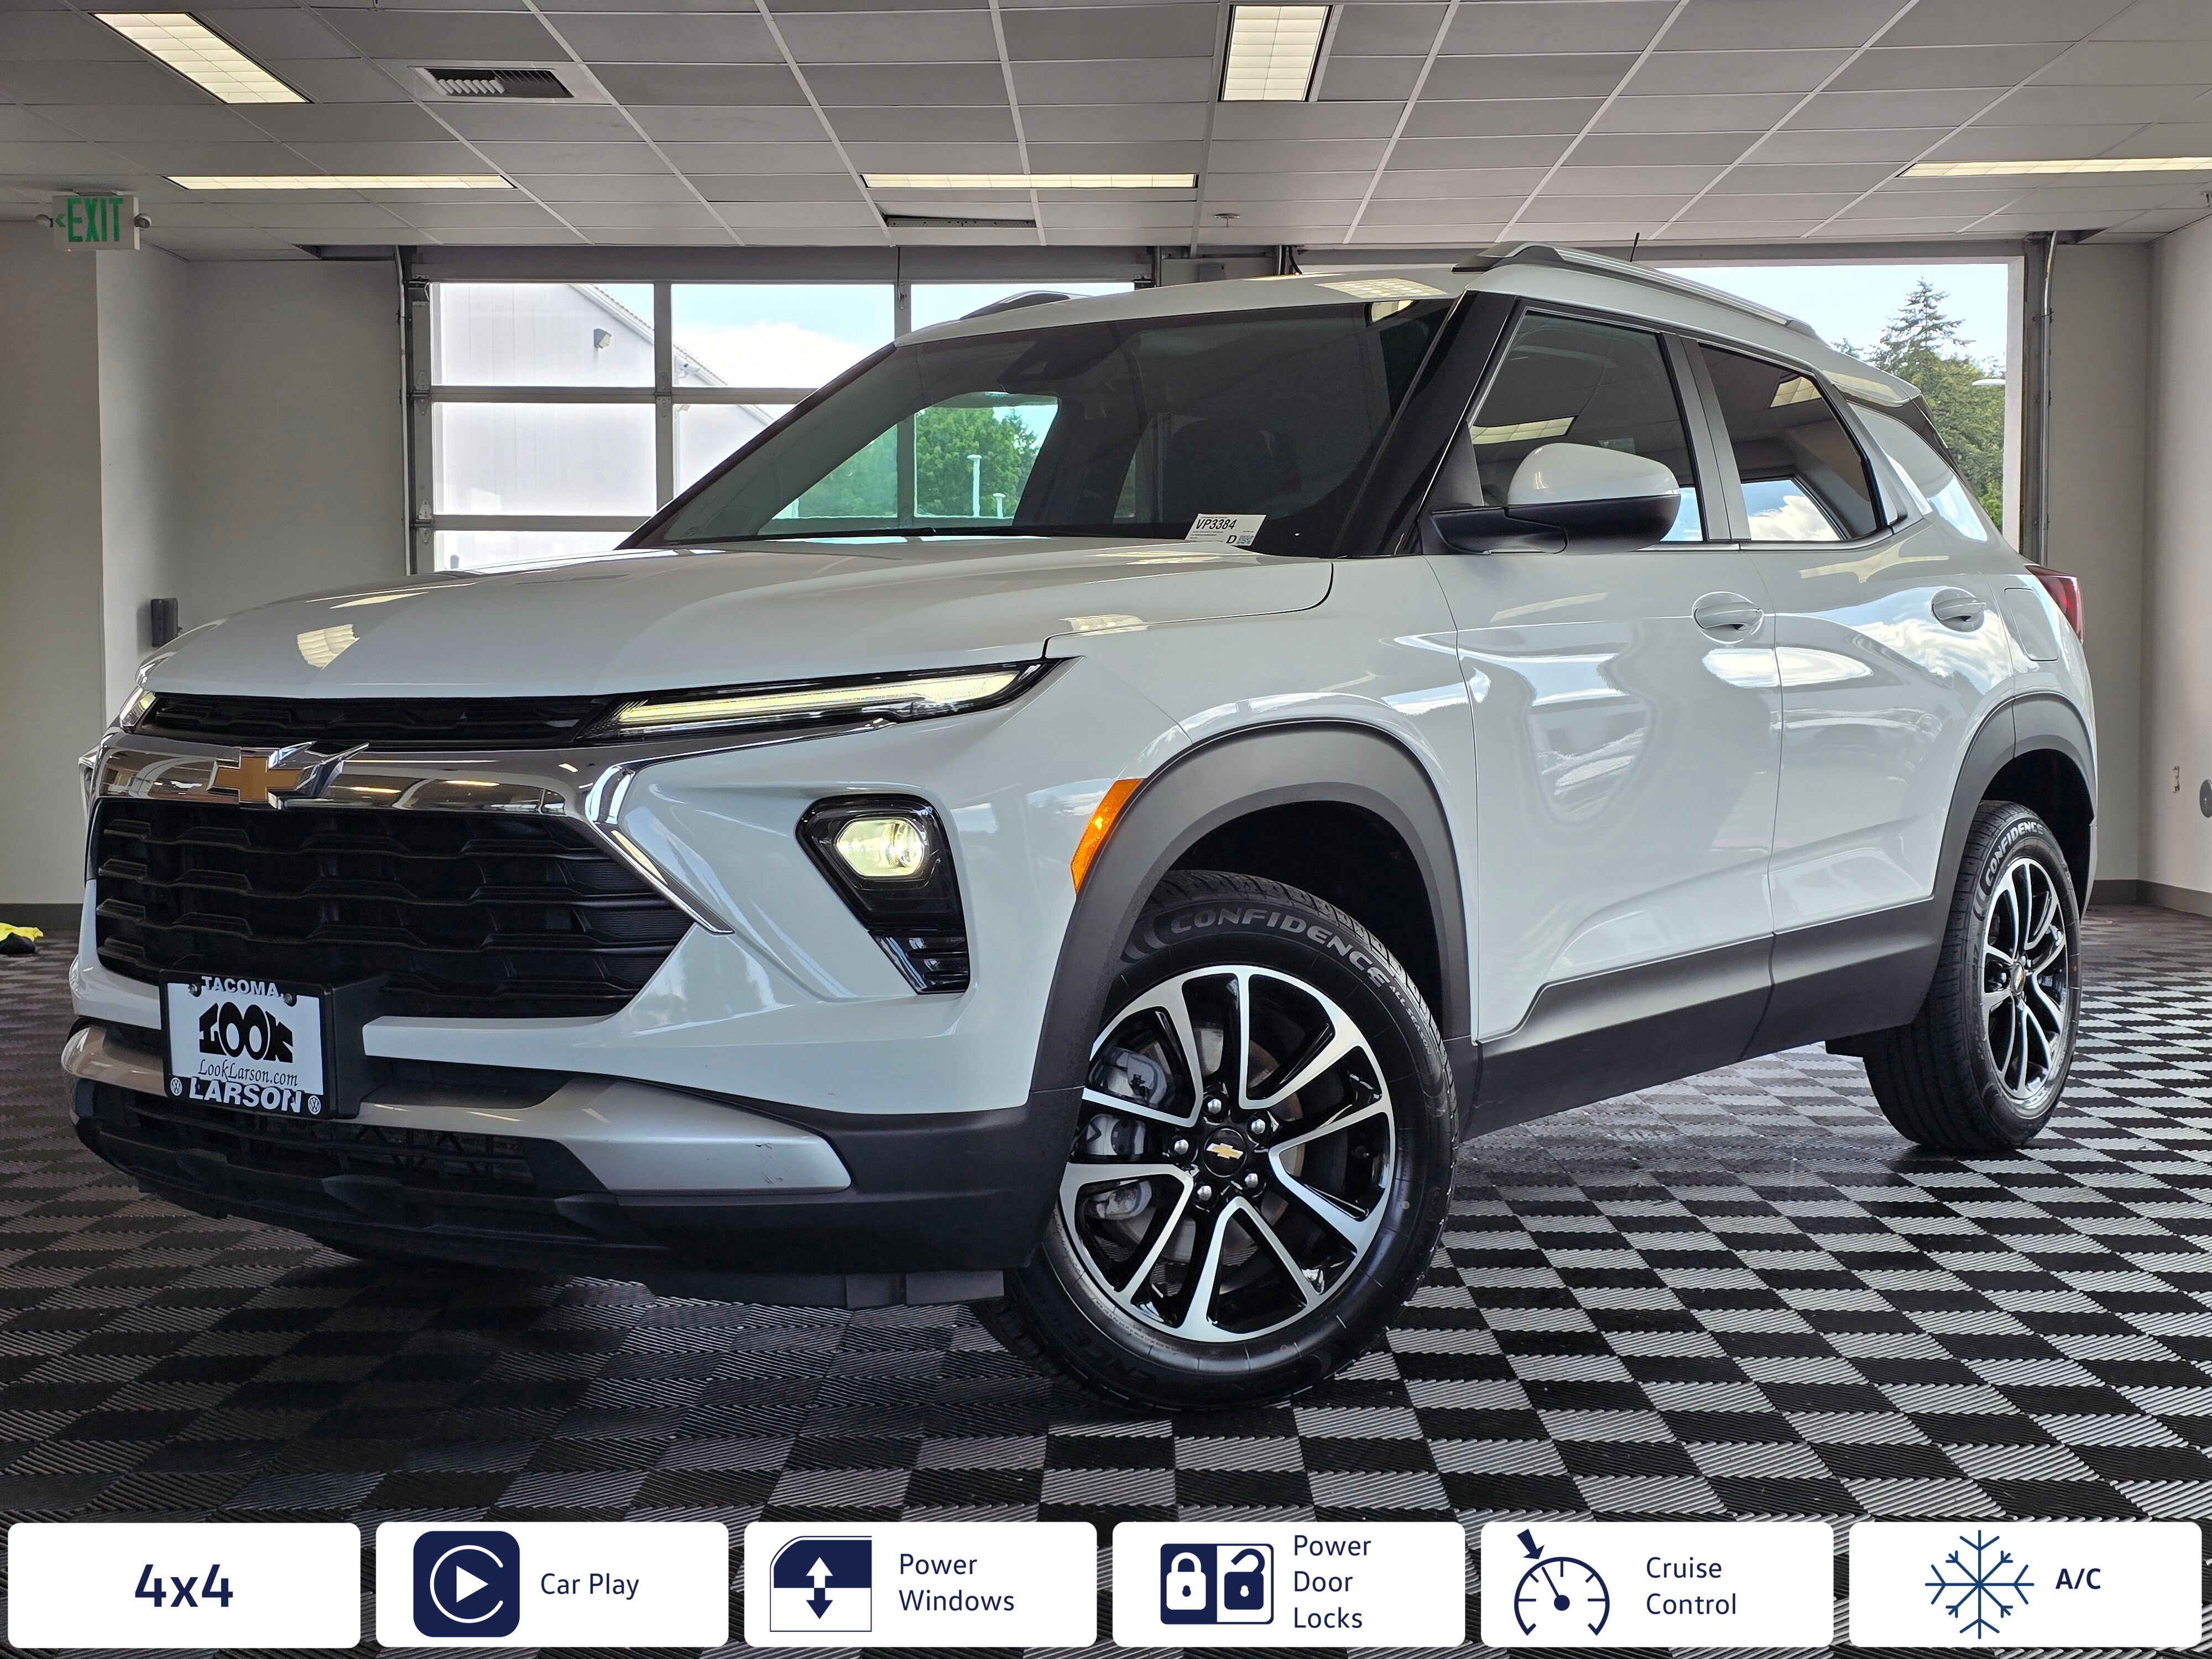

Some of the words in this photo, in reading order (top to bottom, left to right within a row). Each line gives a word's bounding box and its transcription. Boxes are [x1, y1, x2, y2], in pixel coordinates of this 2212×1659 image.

[67, 198, 123, 242] EXIT
[1196, 519, 1237, 529] VP3384
[1226, 535, 1237, 544] D
[1985, 821, 2044, 886] CONFIDENCE
[201, 975, 280, 997] TACOMA
[1170, 907, 1390, 988] CONFIDENCE
[1389, 985, 1406, 1007] ALL
[1406, 1008, 1431, 1055] SEASON
[199, 1001, 293, 1063] LOOK
[198, 1059, 298, 1087] LookLarson.com
[189, 1077, 302, 1113] LARSON
